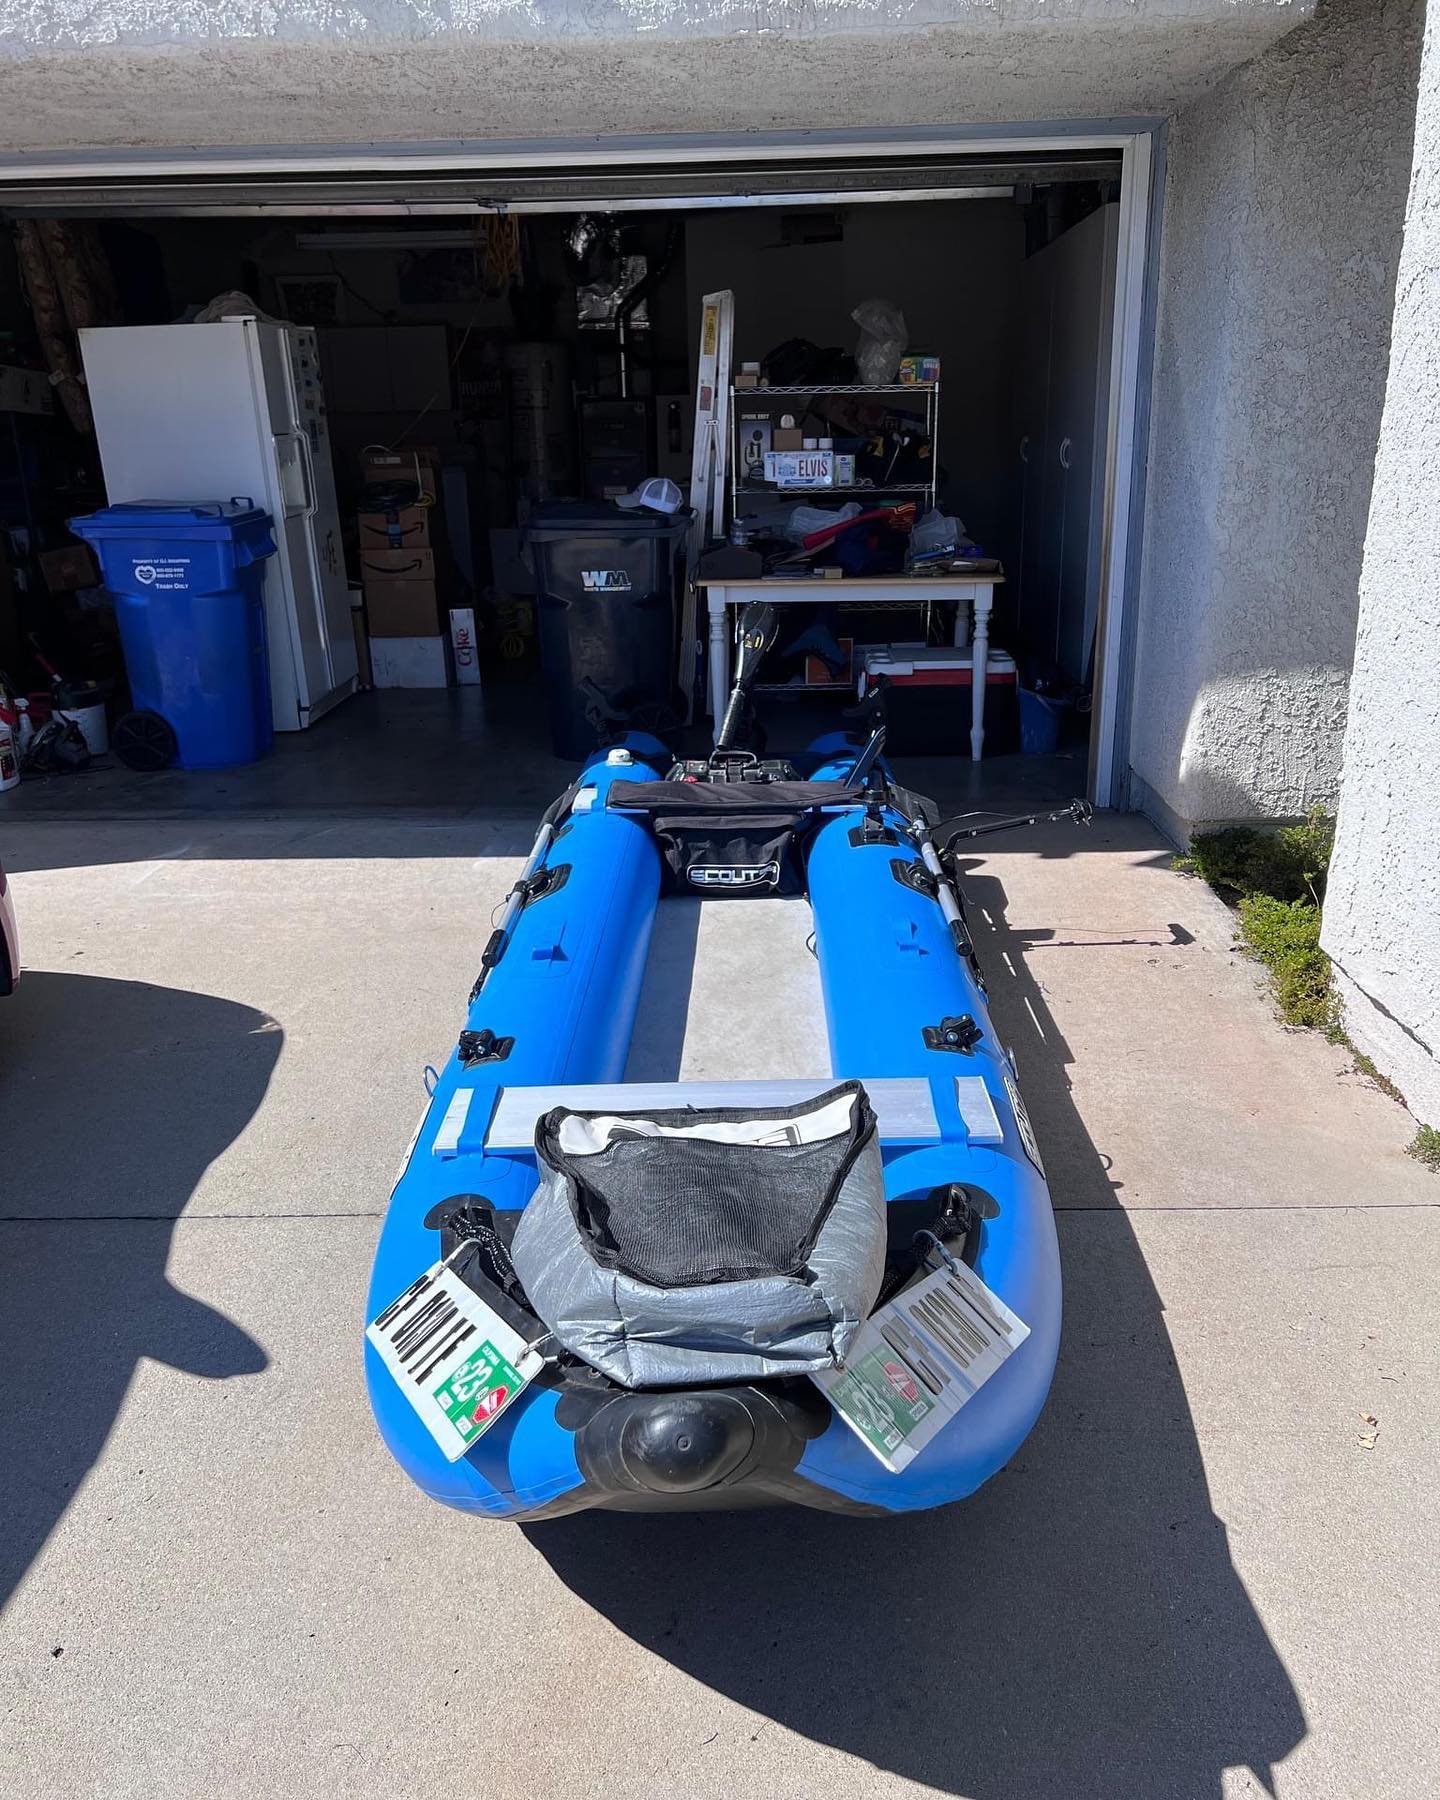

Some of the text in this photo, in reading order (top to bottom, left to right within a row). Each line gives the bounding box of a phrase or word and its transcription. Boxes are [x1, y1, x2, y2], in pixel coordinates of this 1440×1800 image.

[799, 458, 828, 477] ELVIS
[581, 570, 632, 586] WM
[691, 870, 759, 881] SCOUT
[450, 1358, 493, 1402] 23
